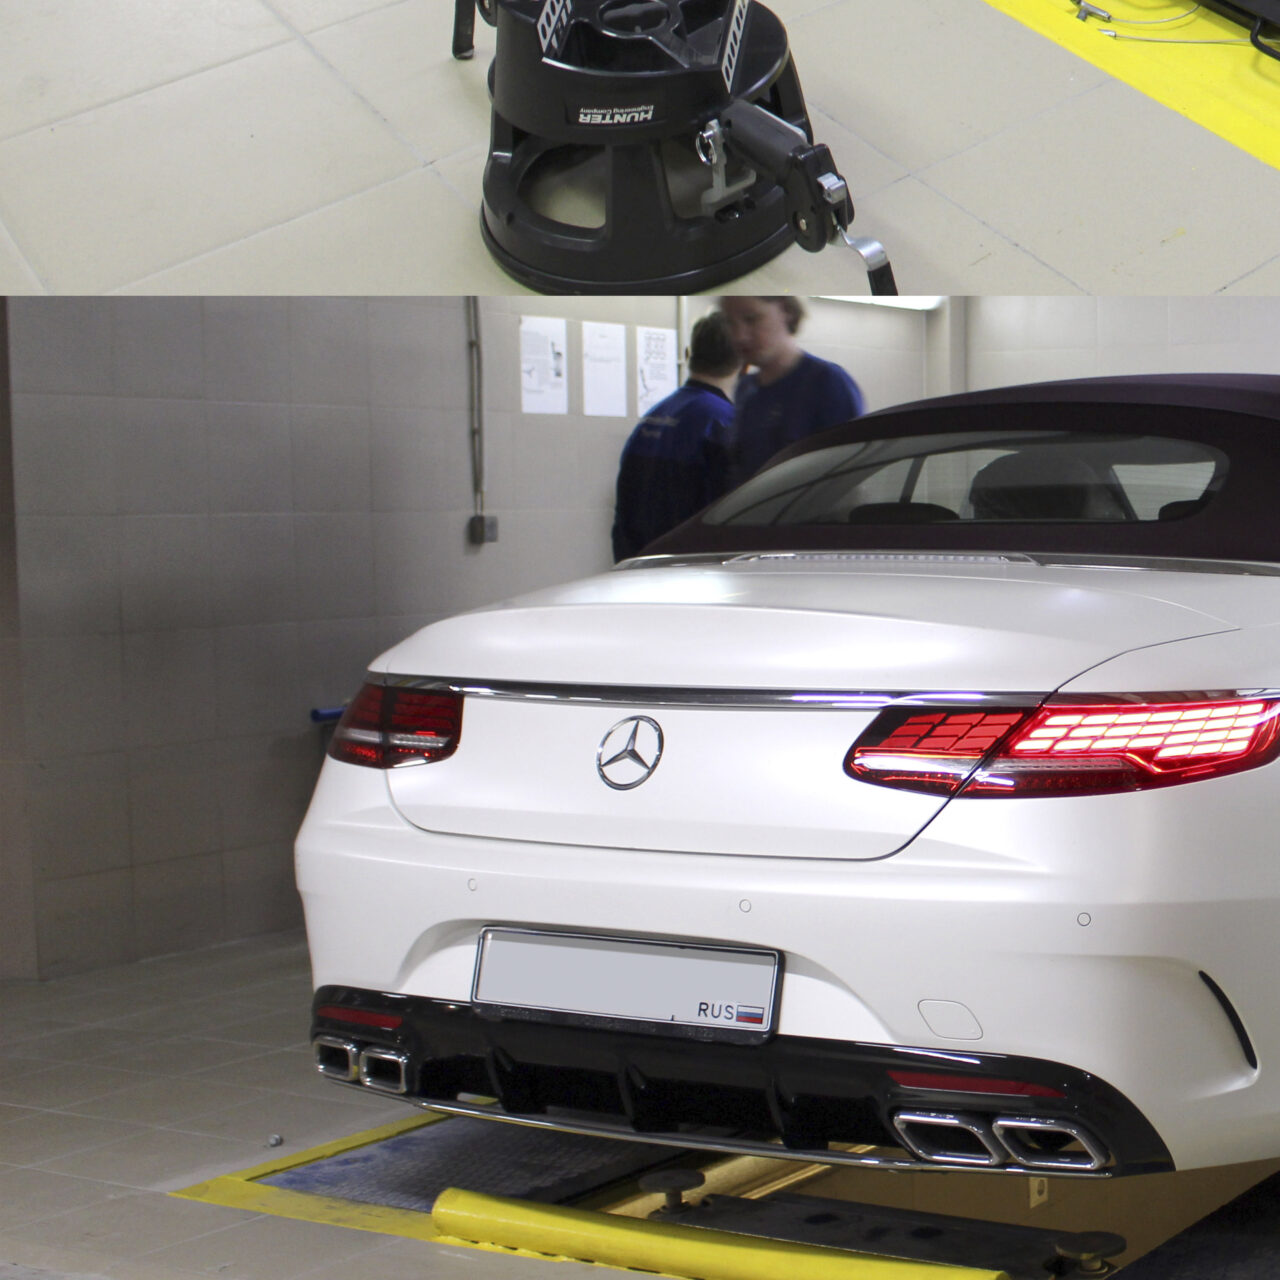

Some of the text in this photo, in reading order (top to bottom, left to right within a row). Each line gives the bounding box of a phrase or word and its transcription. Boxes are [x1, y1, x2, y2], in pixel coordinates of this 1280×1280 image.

[613, 105, 654, 113] Engineering
[578, 110, 653, 124] HUNTER
[697, 1001, 734, 1019] RUS
